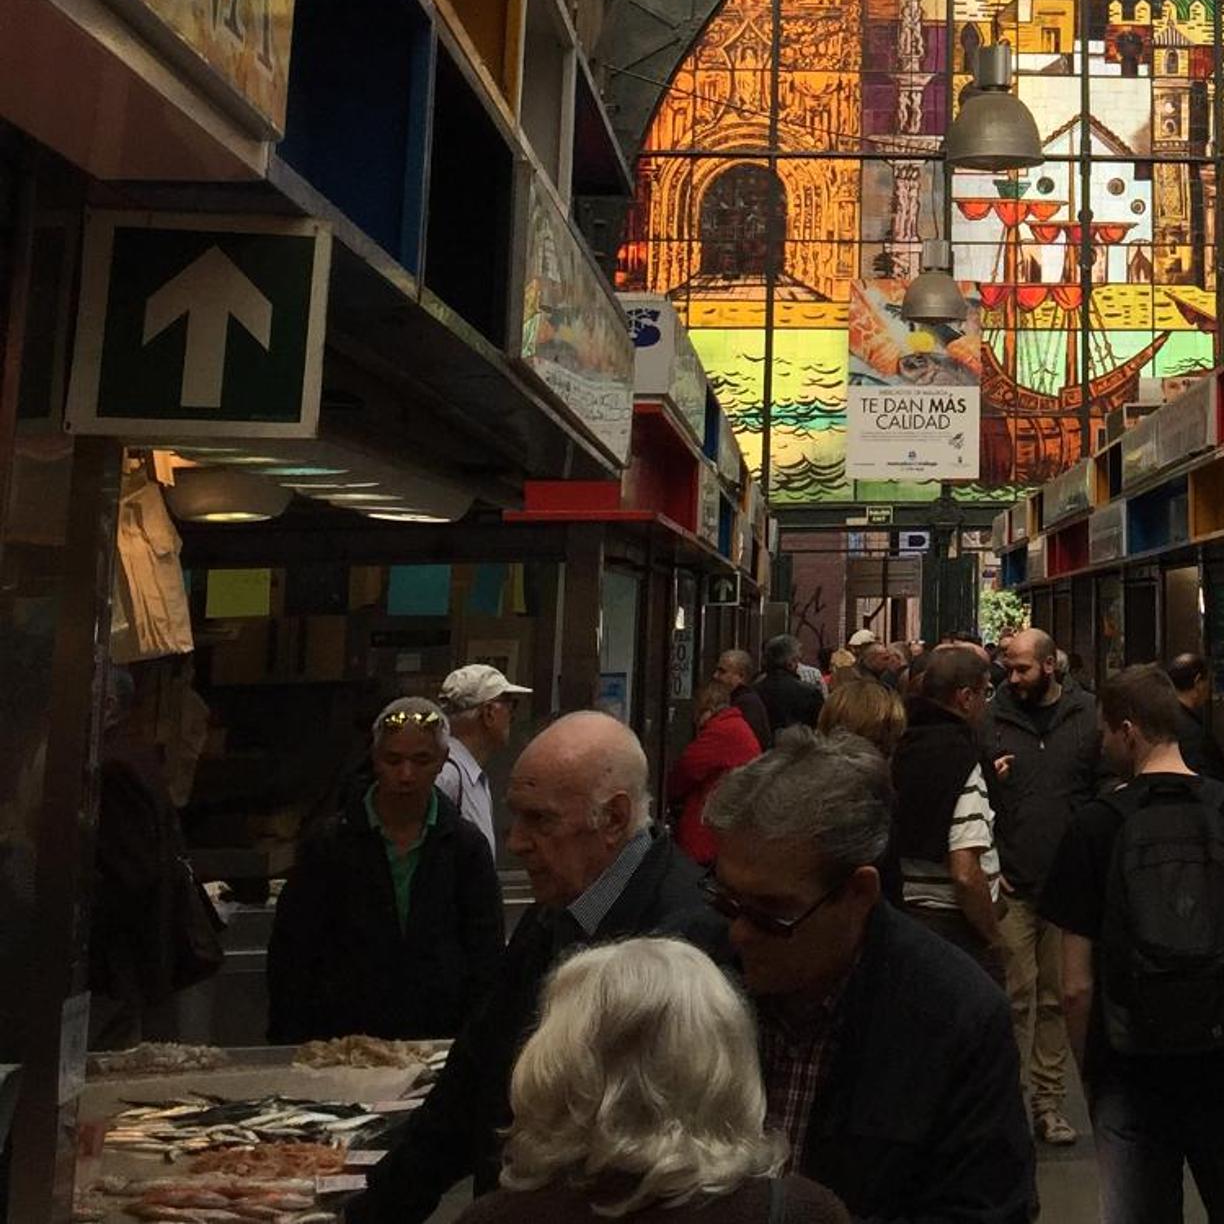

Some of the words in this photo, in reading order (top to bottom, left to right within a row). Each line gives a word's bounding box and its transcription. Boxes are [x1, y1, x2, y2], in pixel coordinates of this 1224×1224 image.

[861, 397, 878, 413] TE
[884, 397, 924, 413] DAN
[929, 393, 967, 413] MÁS
[876, 414, 951, 430] CALIDAD
